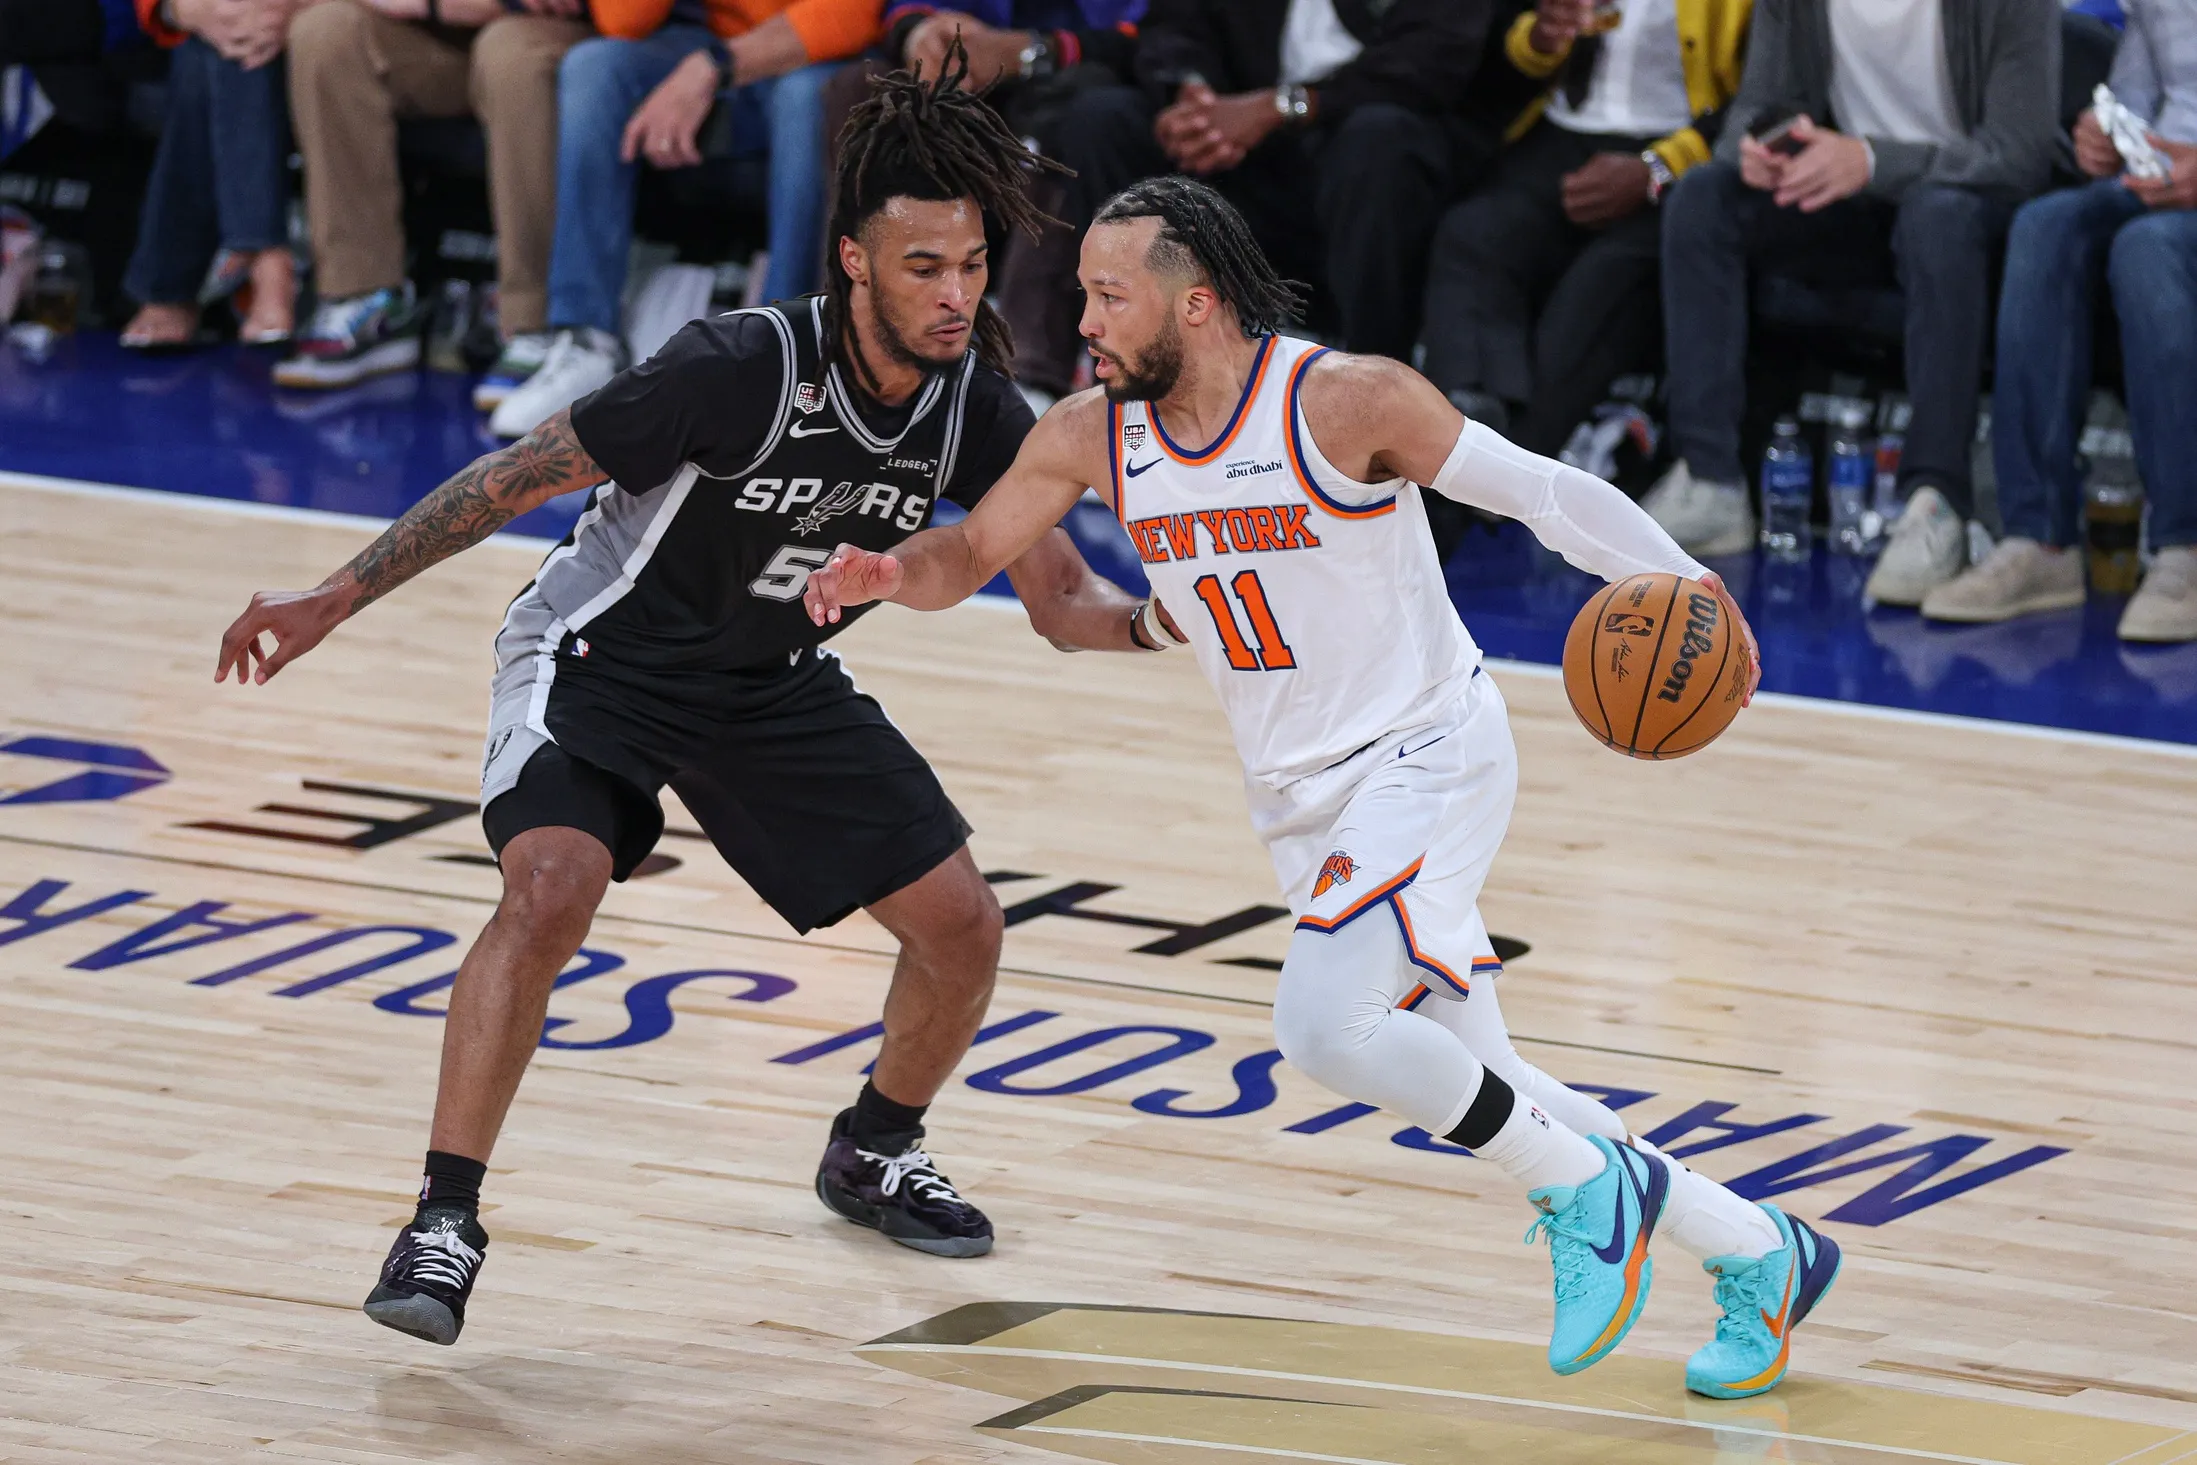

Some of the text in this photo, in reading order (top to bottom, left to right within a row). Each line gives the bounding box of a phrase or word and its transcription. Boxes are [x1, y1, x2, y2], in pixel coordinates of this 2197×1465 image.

[801, 387, 823, 397] US
[797, 398, 822, 409] 250
[1125, 426, 1145, 434] USA
[1125, 437, 1146, 446] 250
[887, 457, 930, 472] LEDGER
[1225, 459, 1256, 469] experience
[1226, 459, 1283, 479] abu dhabi
[733, 477, 930, 538] SPURS
[1127, 503, 1323, 565] NEW YORK
[747, 544, 834, 604] 5
[1193, 569, 1298, 672] 11
[1656, 592, 1718, 705] Wilson
[769, 1011, 2072, 1227] MASO
